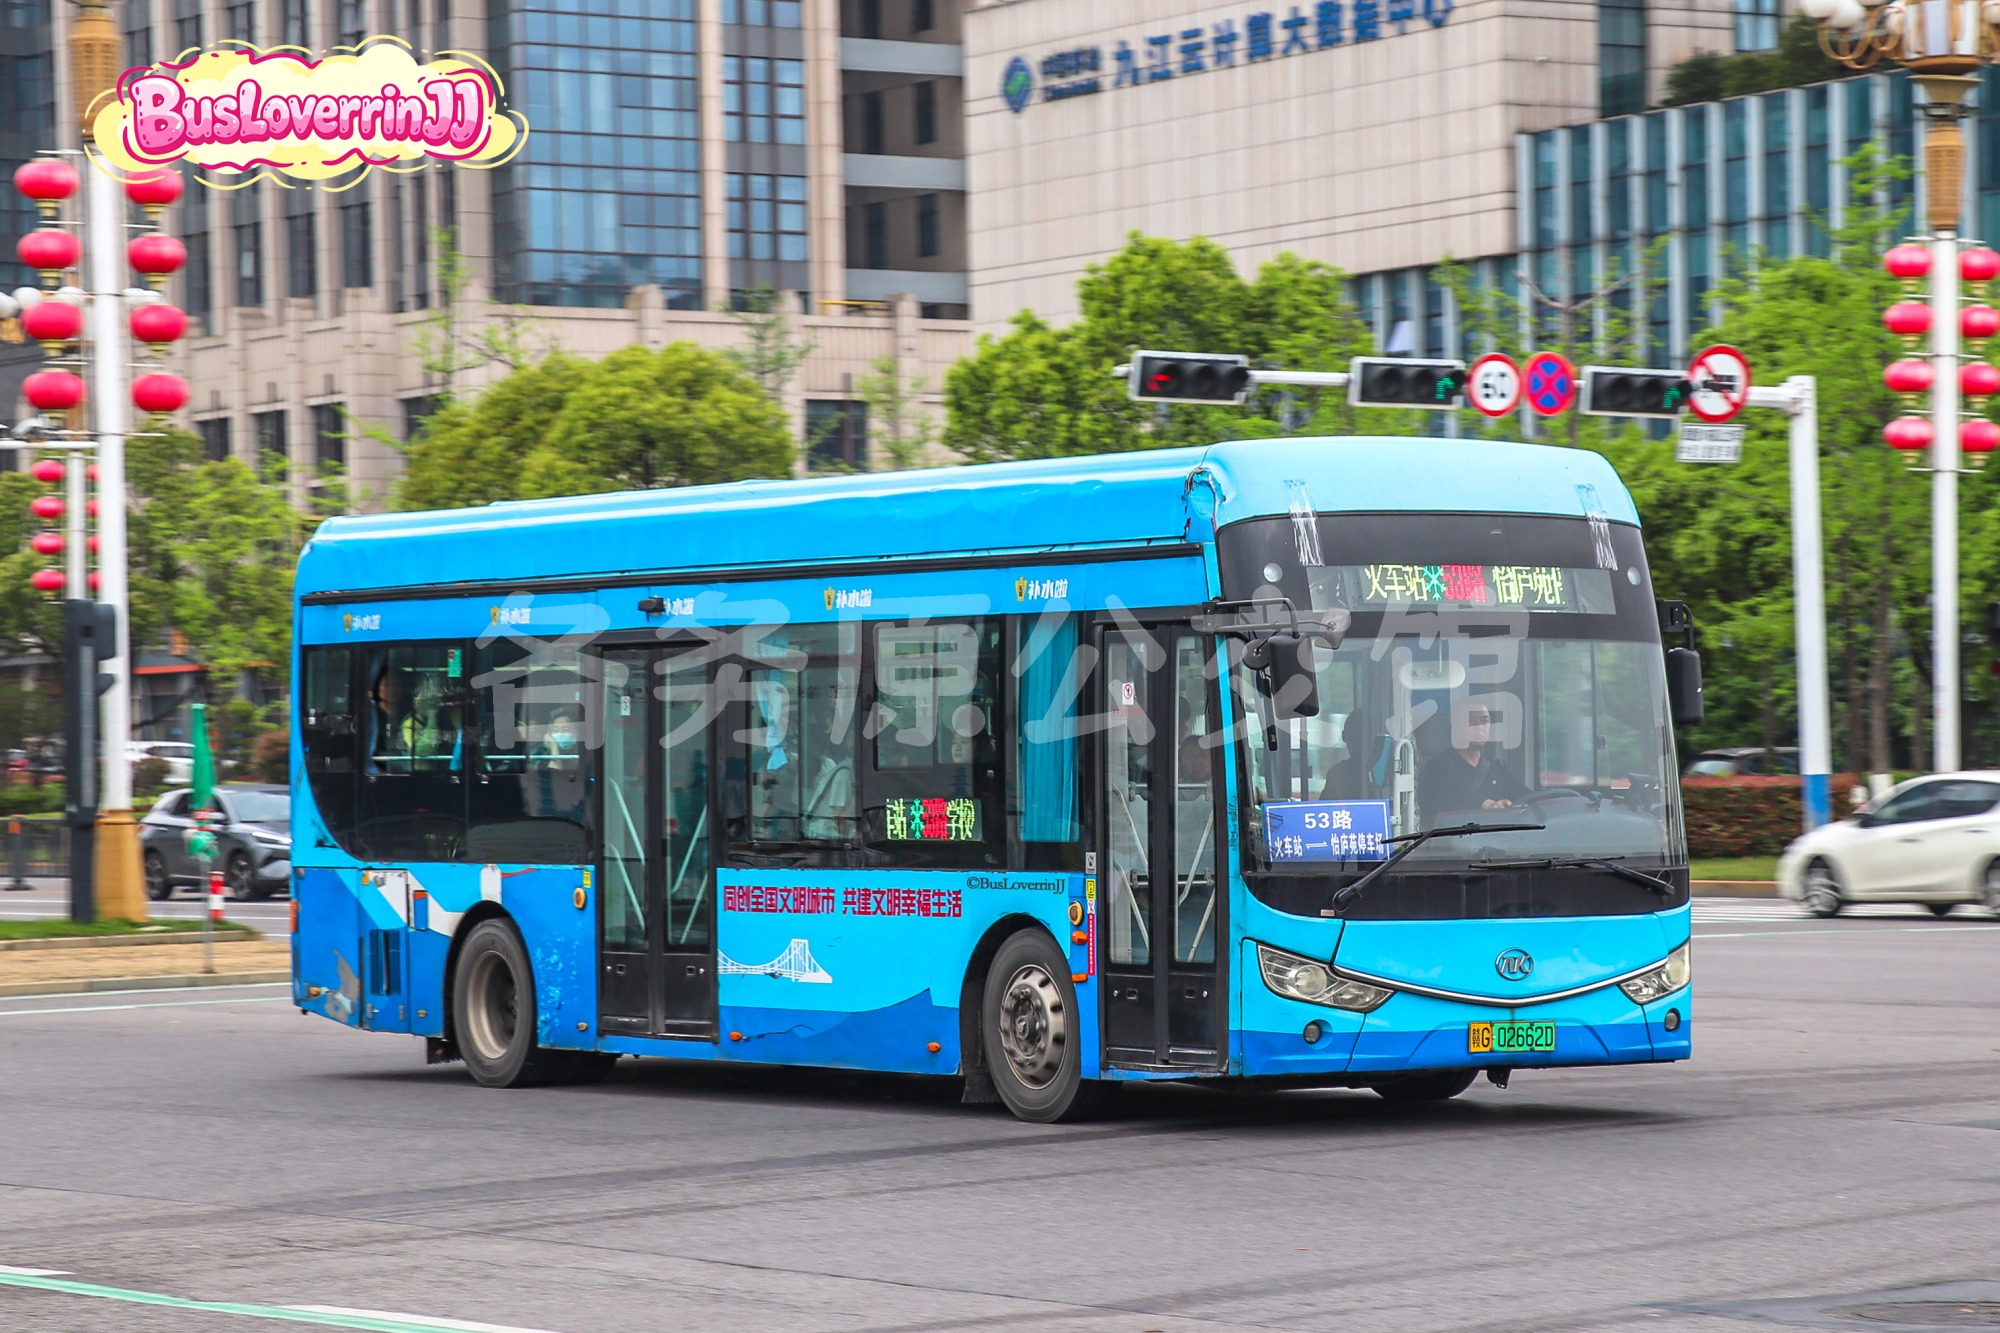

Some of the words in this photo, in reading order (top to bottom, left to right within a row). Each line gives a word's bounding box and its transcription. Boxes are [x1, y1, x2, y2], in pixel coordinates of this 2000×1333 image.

[1028, 578, 1068, 599] 补水啦
[1364, 564, 1427, 601] 火车站
[1304, 810, 1352, 830] 53路
[1275, 835, 1303, 858] 火车站
[1331, 832, 1384, 856] 怡庐苑停车场
[723, 885, 835, 914] 同创全国文明城市
[842, 887, 962, 917] 共建文明幸福生活
